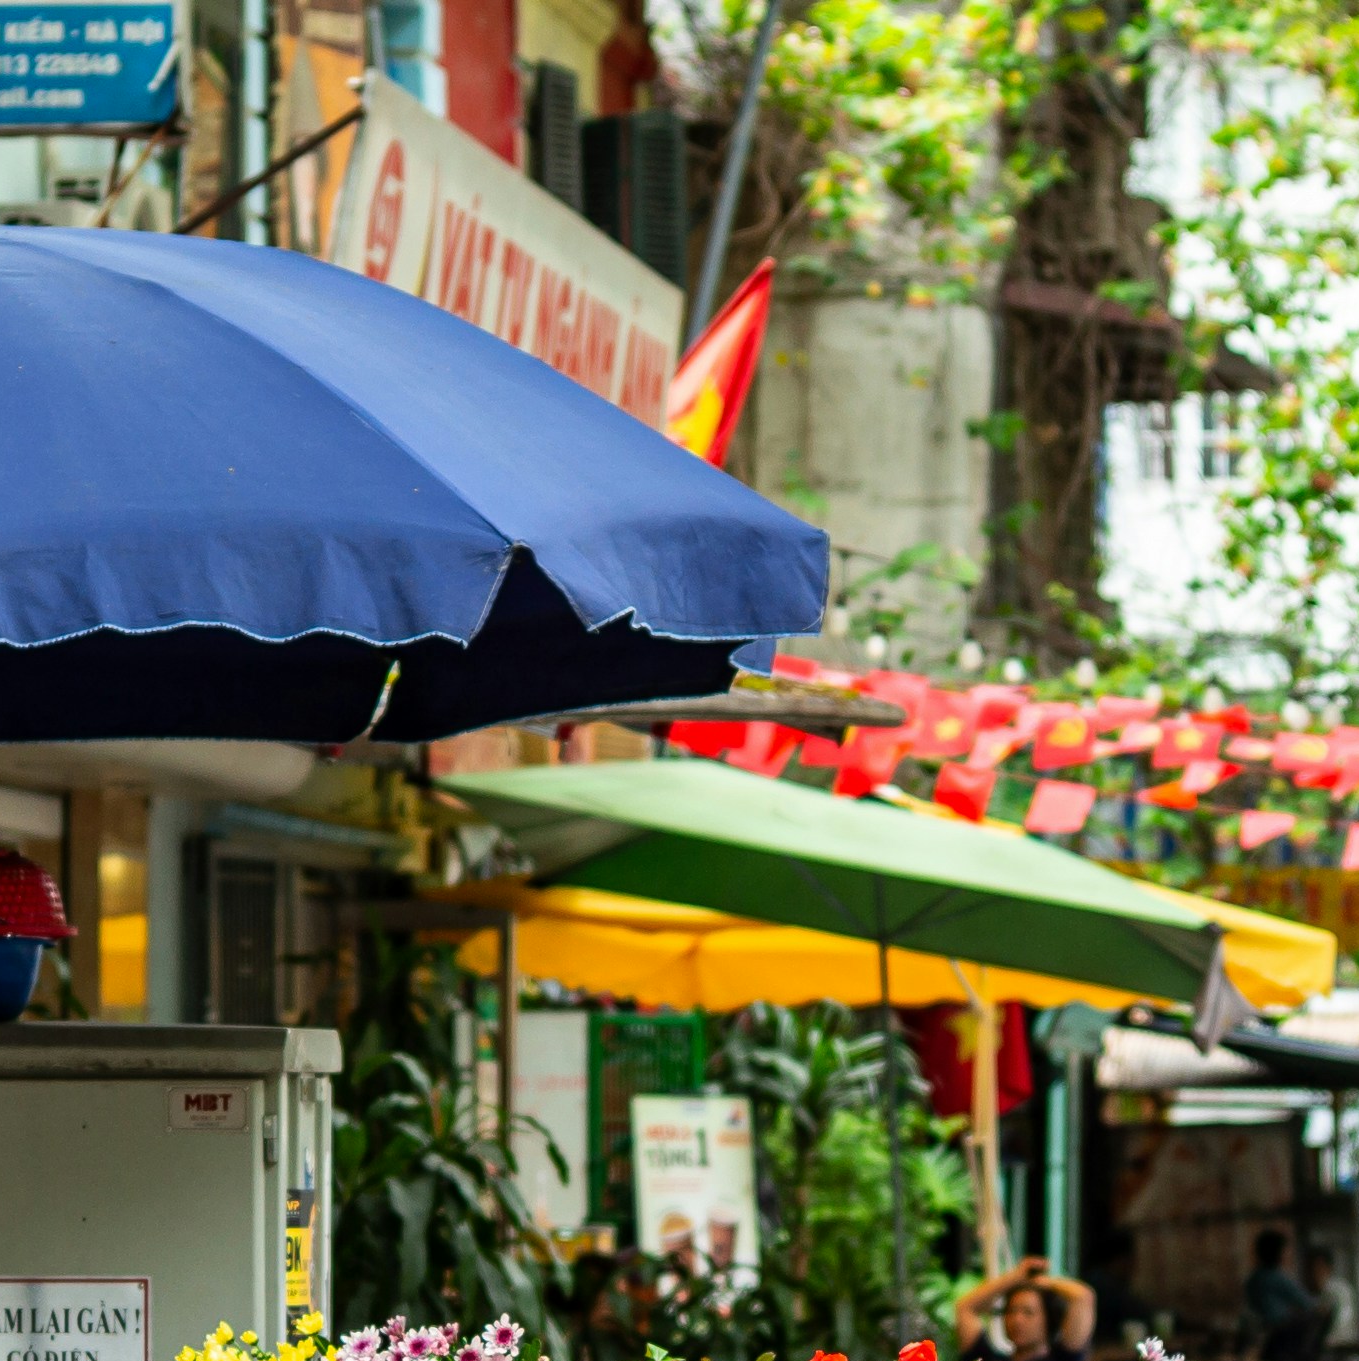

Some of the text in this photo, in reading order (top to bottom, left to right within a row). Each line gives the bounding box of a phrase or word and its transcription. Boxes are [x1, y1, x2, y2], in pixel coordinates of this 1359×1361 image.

[184, 1093, 233, 1112] MBT
[30, 1308, 70, 1341] LẠI
[77, 1300, 128, 1334] GẦN
